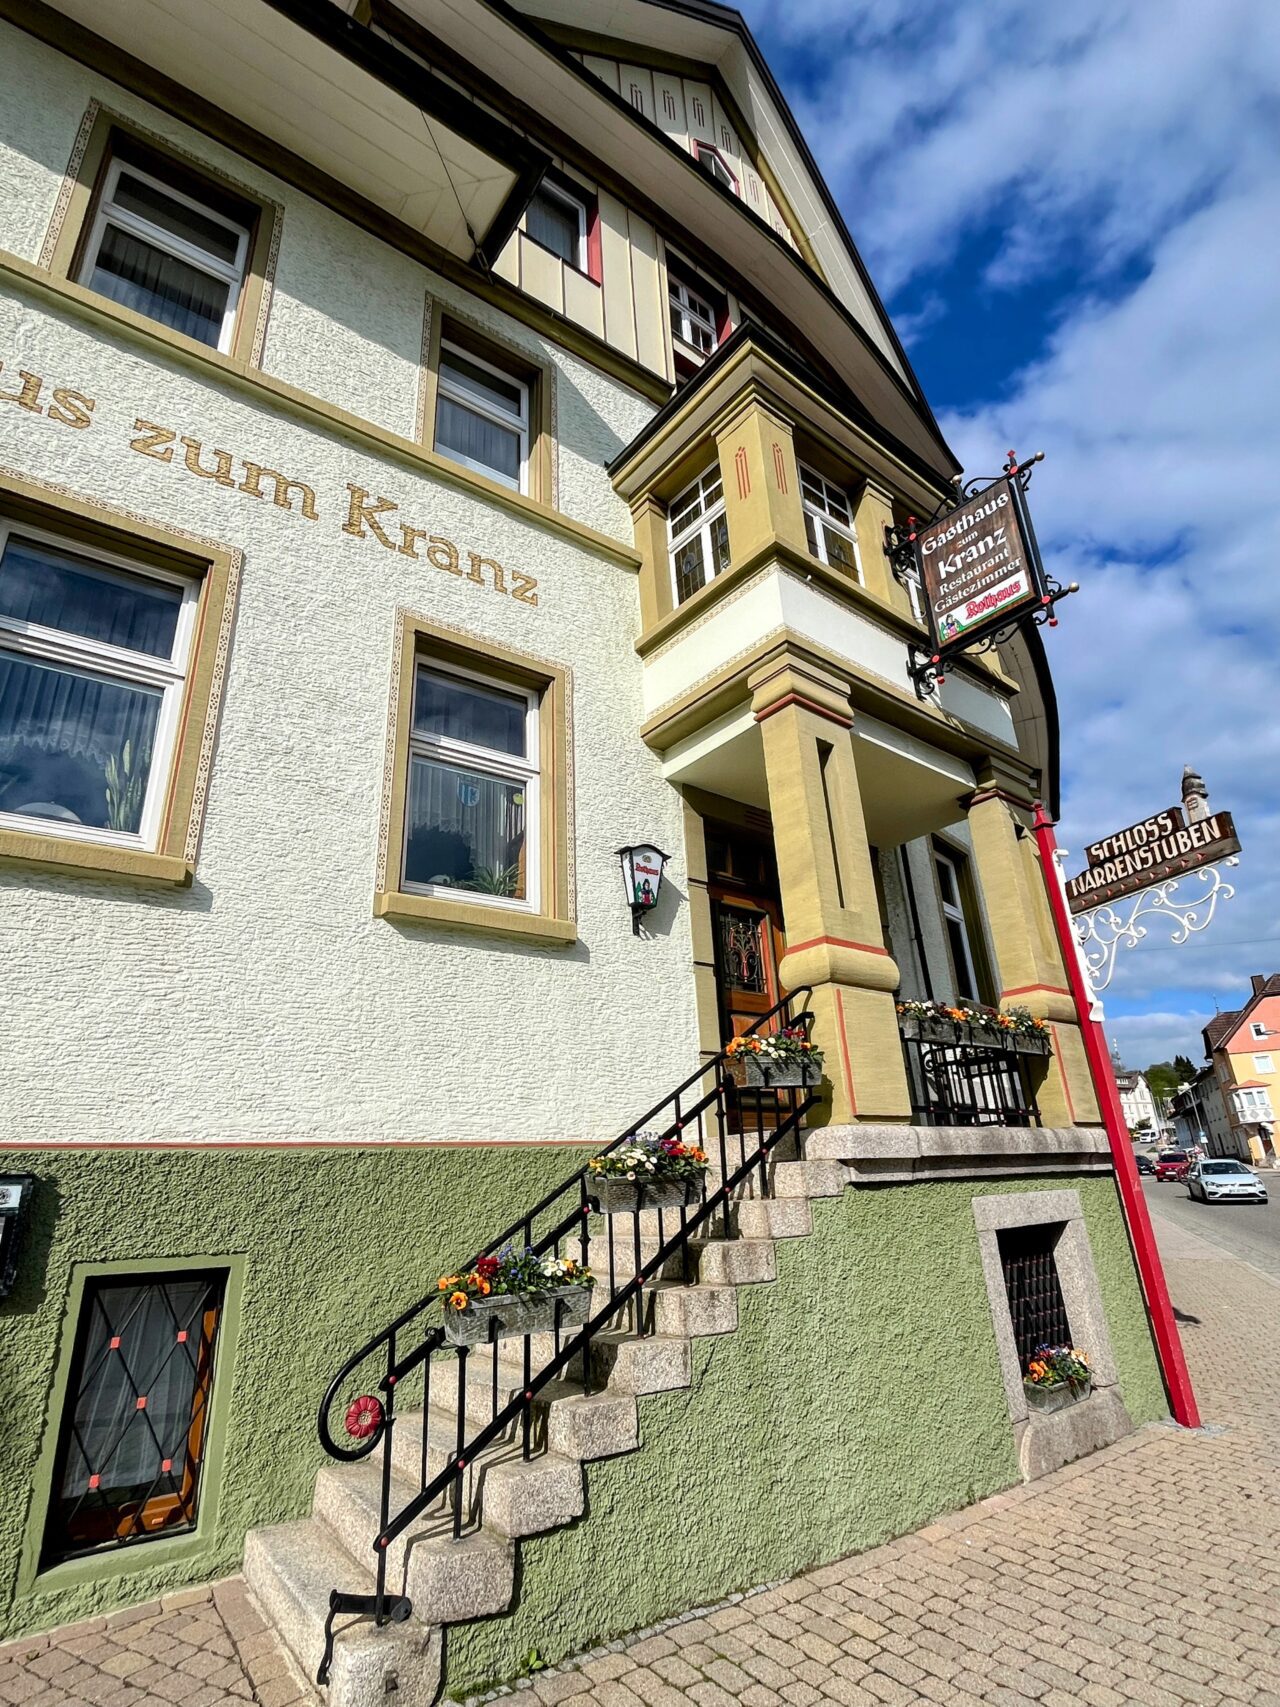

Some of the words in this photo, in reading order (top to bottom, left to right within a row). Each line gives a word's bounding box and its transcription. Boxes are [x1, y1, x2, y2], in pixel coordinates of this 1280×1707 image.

[130, 418, 319, 521] zum
[341, 482, 539, 607] Kranz
[921, 491, 1009, 556] Gasthaus
[956, 530, 979, 548] zum
[937, 526, 1008, 580] Kranz
[939, 547, 1010, 597] Restaurant
[934, 557, 1022, 613] Gästezimmer
[966, 580, 1022, 620] Rothaus
[1070, 816, 1222, 897] NARRENSTUBEN
[1090, 812, 1173, 861] SCHLOSS
